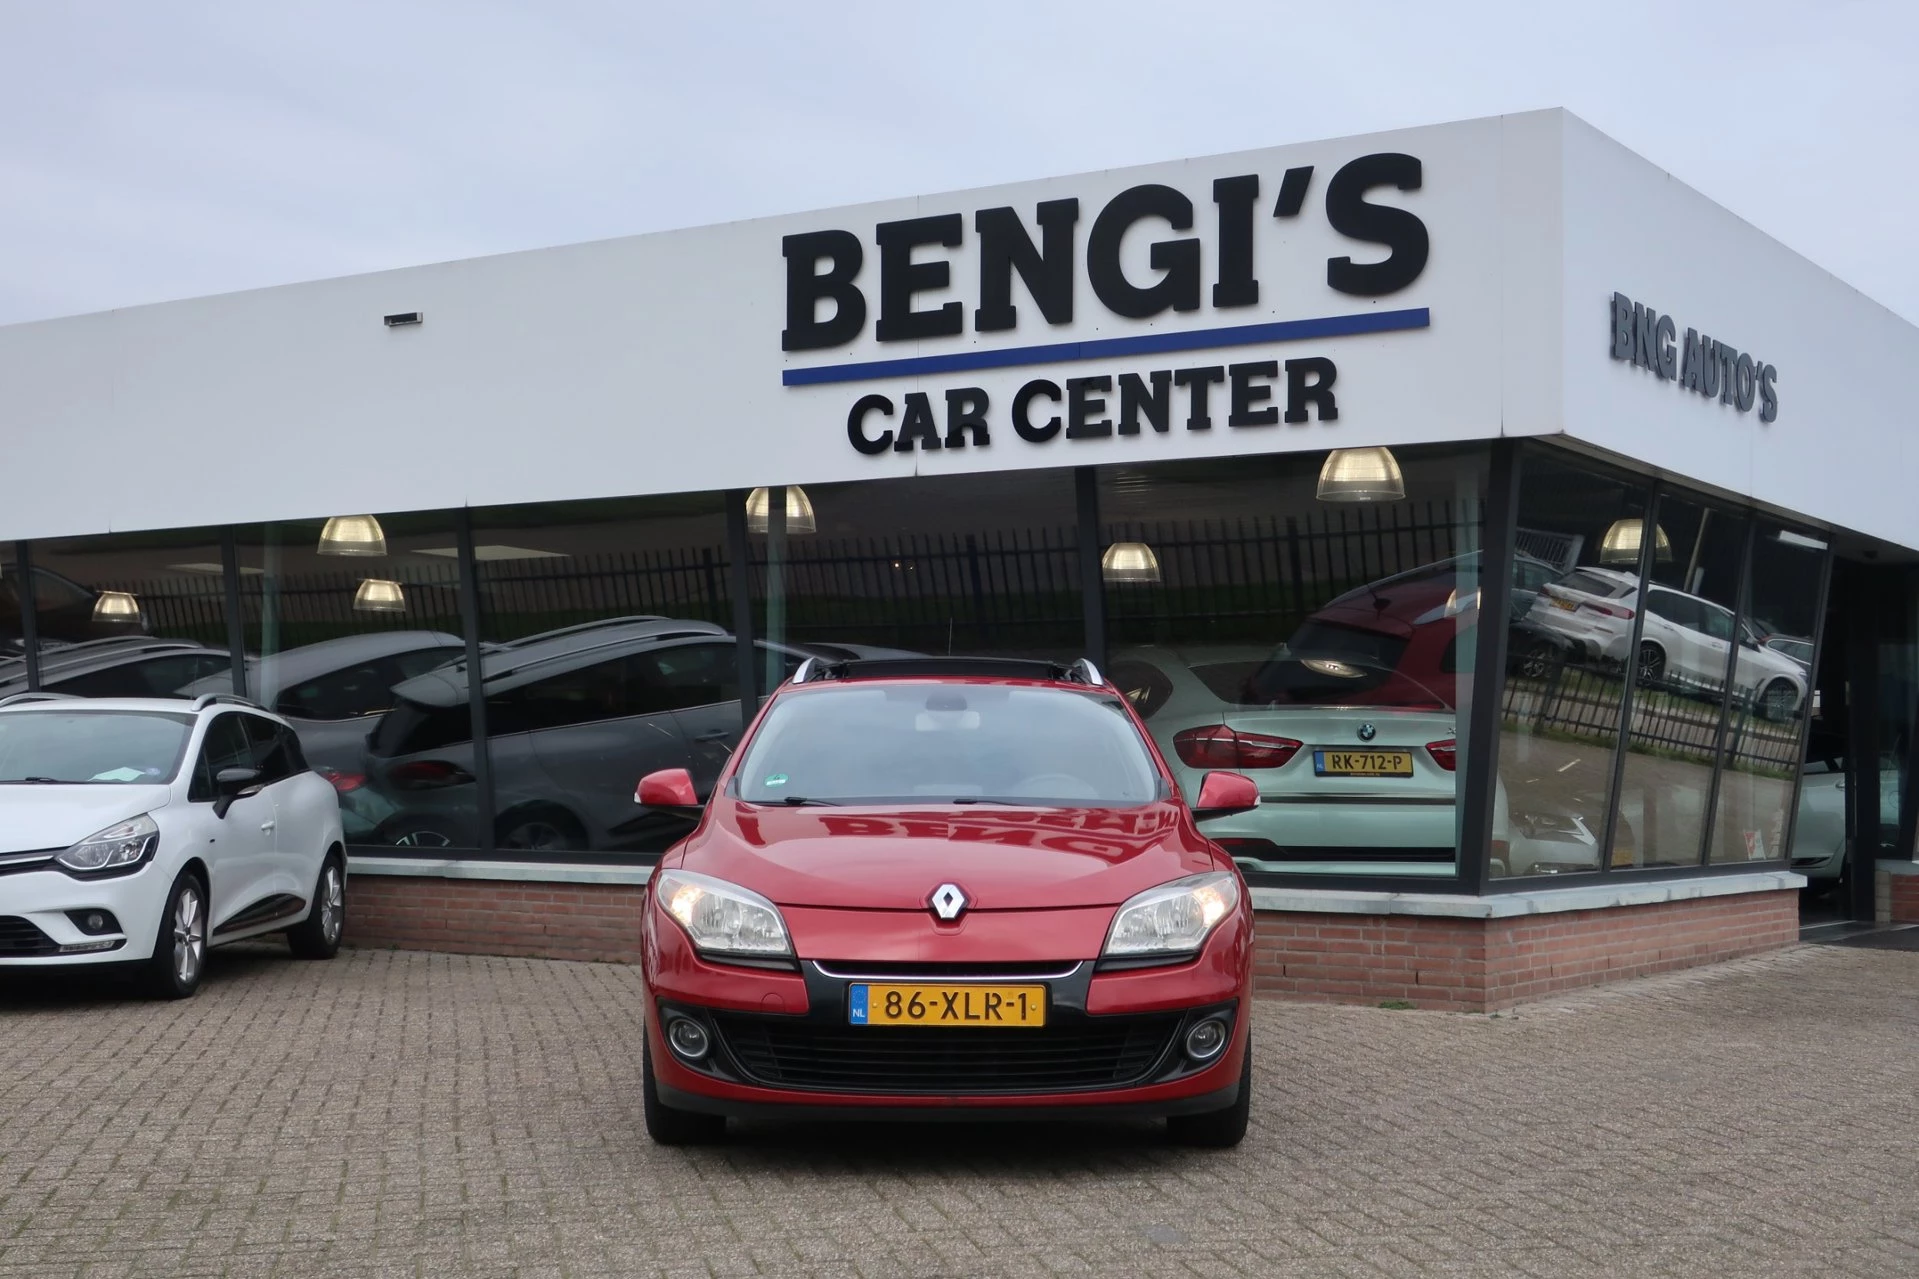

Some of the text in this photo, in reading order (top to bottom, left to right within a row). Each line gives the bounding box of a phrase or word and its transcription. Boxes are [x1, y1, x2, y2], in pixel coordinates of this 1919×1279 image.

[781, 152, 1430, 352] BENGI'S
[847, 356, 1339, 456] CAR CENTER
[1609, 291, 1778, 424] BNG AUTO'S
[1331, 754, 1402, 770] RK-712-P
[852, 990, 1028, 1021] NL 86-XLR-1
